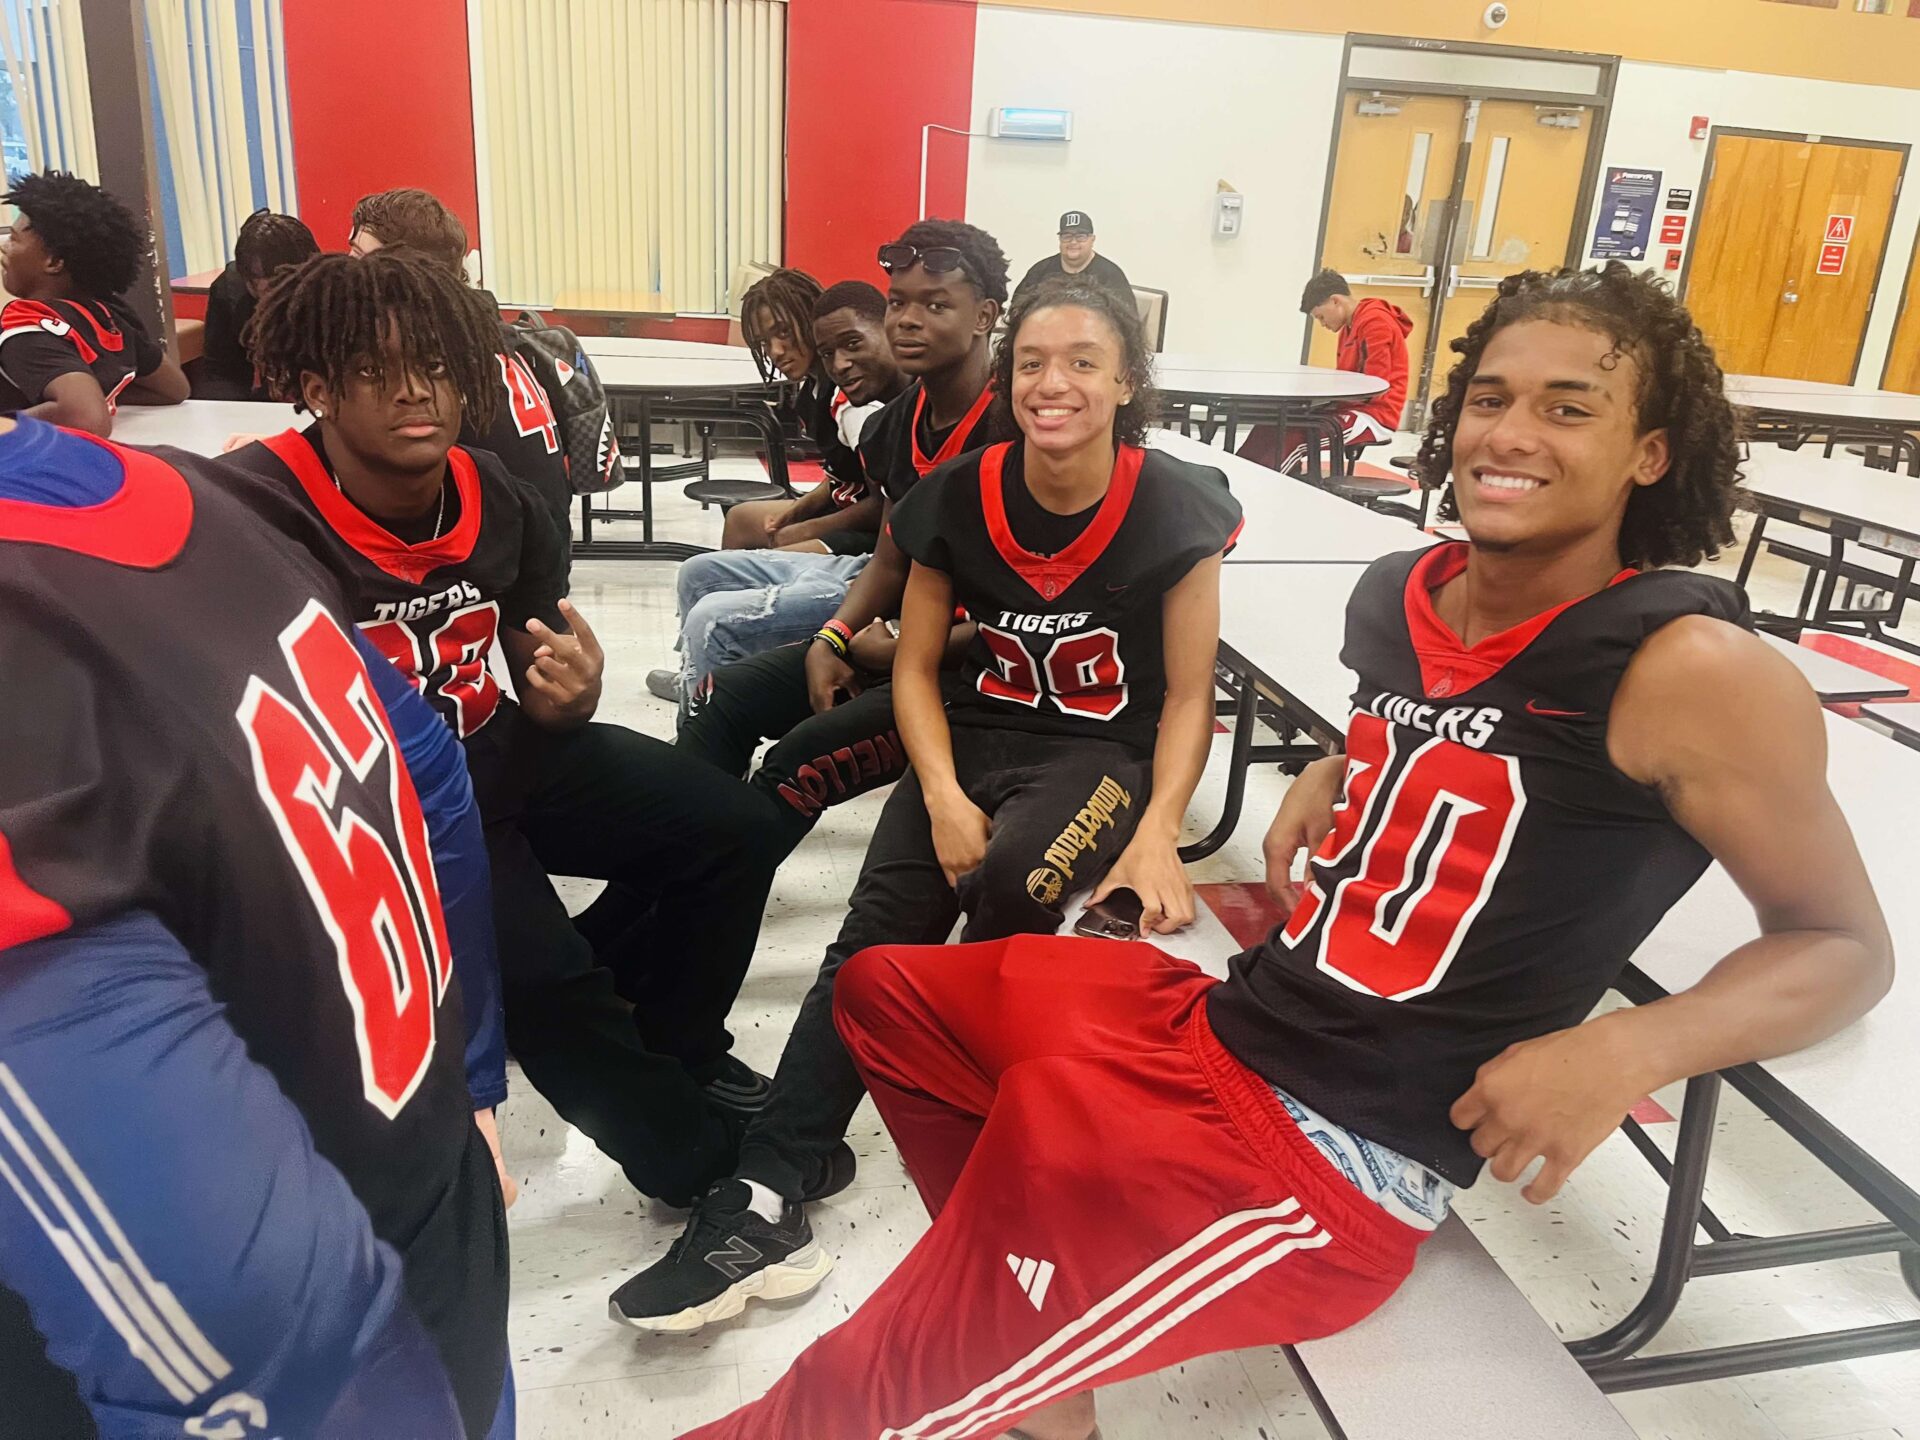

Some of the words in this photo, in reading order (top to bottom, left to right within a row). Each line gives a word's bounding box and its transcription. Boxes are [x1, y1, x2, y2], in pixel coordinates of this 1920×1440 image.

[1066, 213, 1081, 227] D
[374, 580, 482, 622] TIGERS
[997, 610, 1094, 635] TIGERS
[1371, 691, 1504, 750] TIGERS
[1044, 775, 1132, 881] Timberland
[703, 1235, 764, 1279] N
